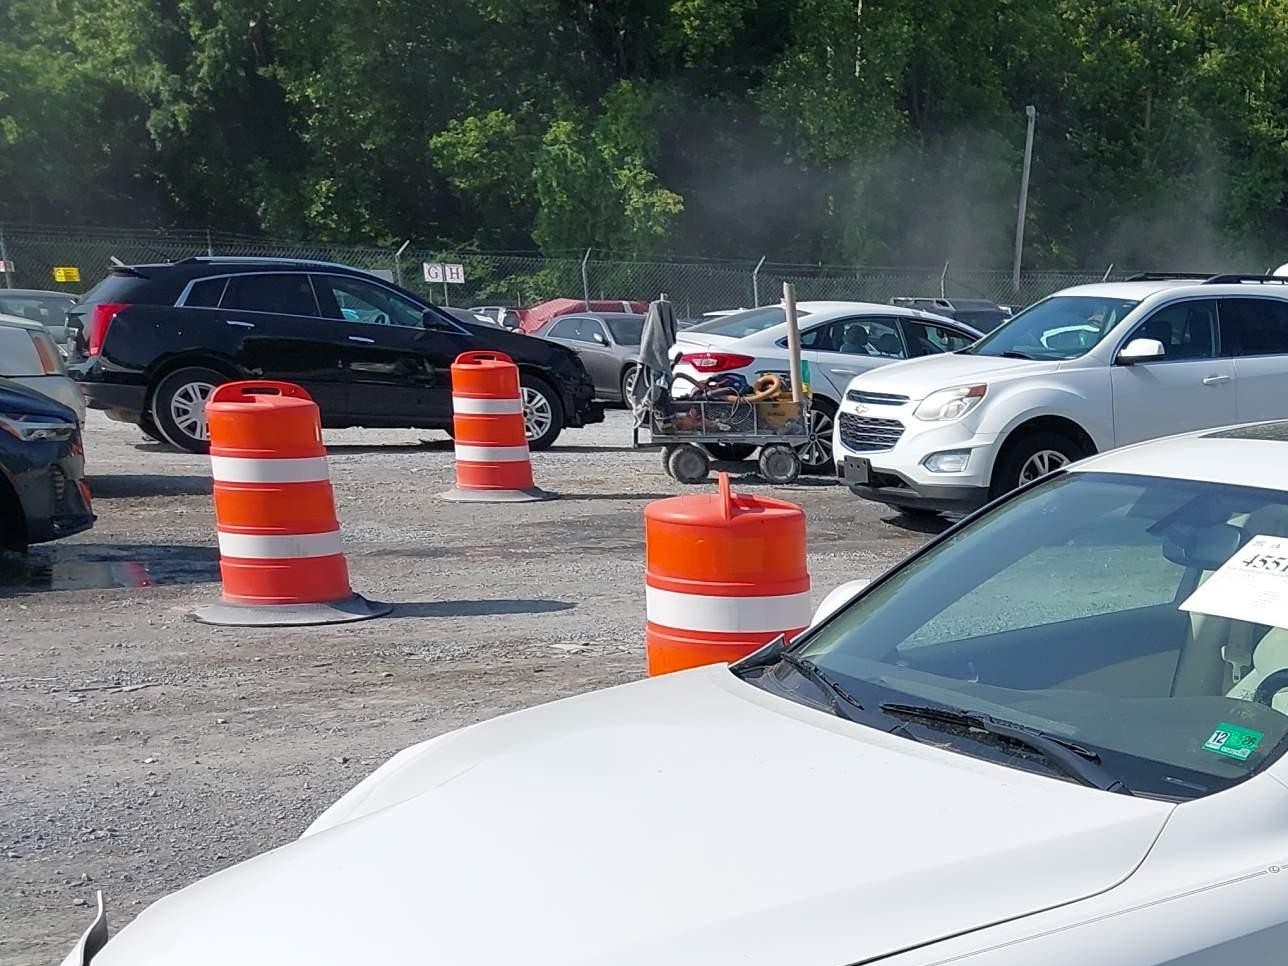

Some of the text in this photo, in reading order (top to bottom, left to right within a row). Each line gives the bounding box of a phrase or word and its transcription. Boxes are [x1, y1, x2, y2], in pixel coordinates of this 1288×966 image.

[428, 265, 439, 279] G
[450, 267, 460, 280] H
[1212, 731, 1229, 744] 12
